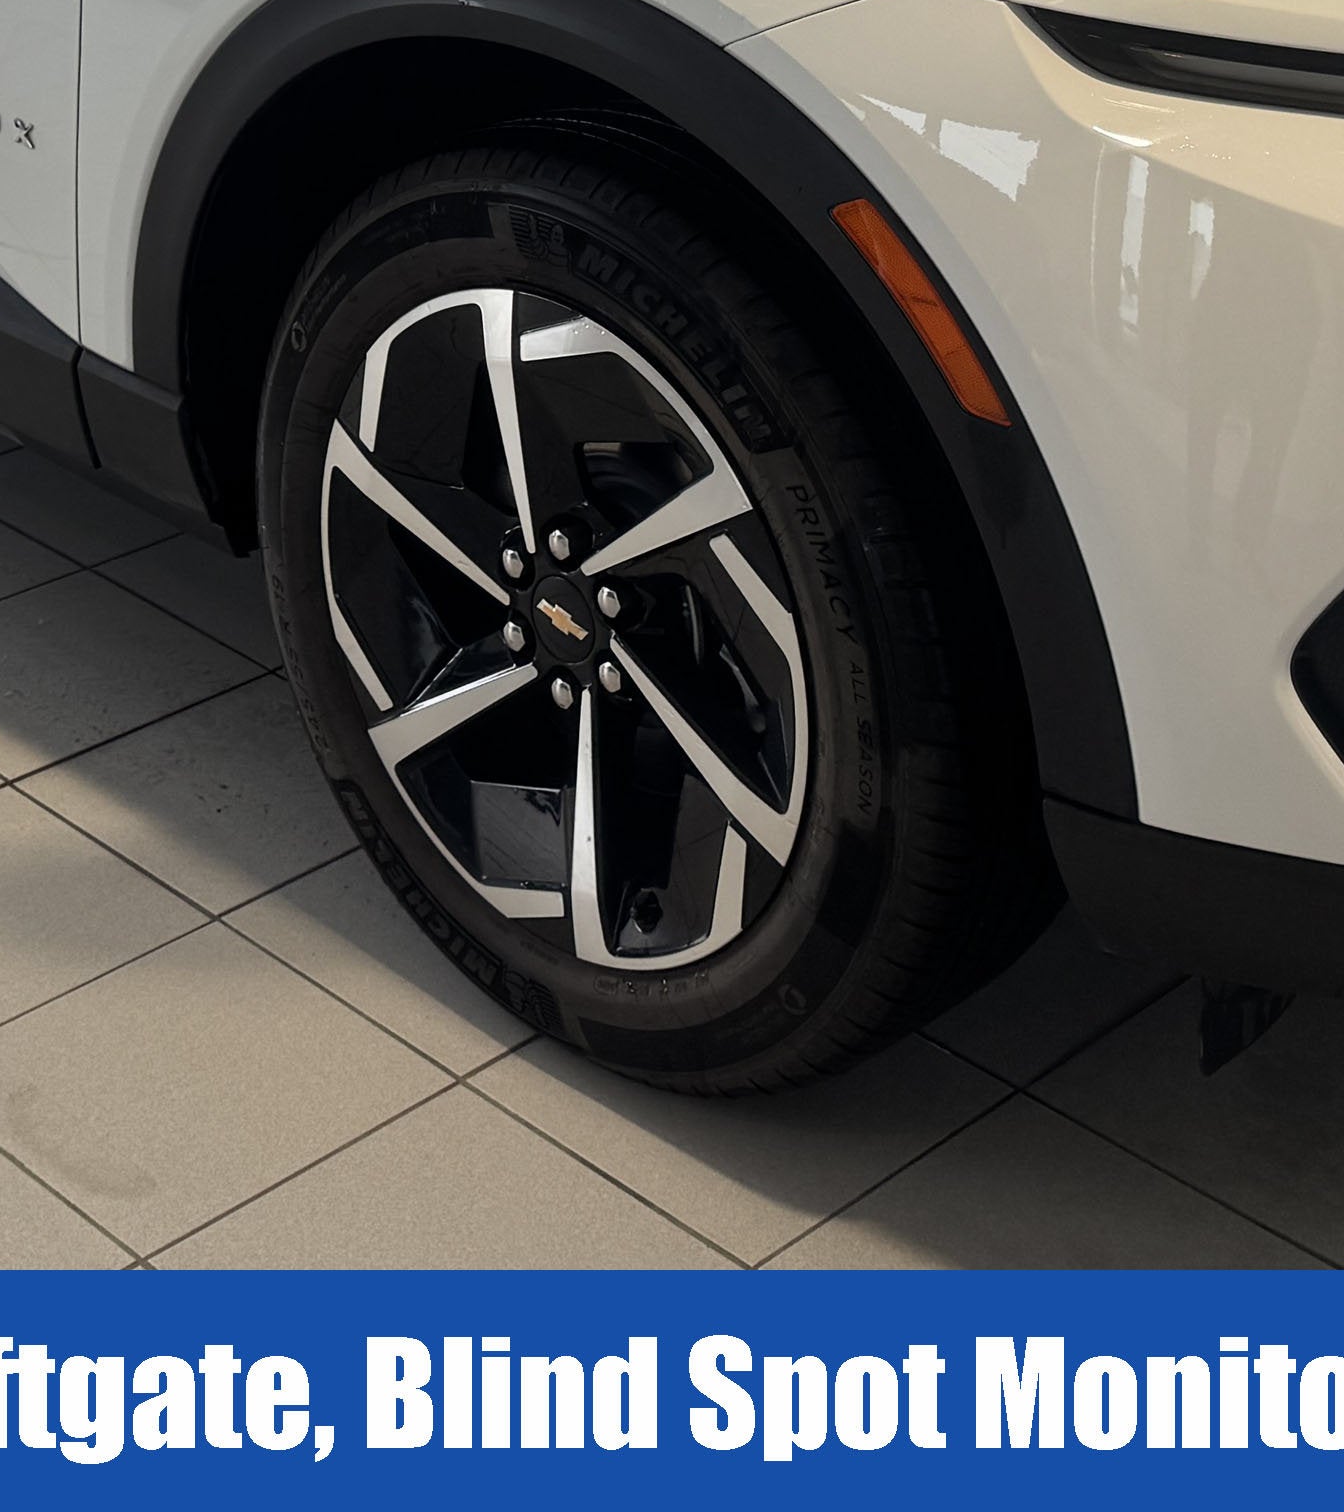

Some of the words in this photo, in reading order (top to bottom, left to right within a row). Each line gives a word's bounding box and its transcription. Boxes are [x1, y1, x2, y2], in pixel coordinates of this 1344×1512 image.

[577, 243, 773, 443] MICHELIN
[785, 484, 859, 644] PRIMACY
[849, 659, 867, 705] ALL
[855, 716, 874, 817] SEASON
